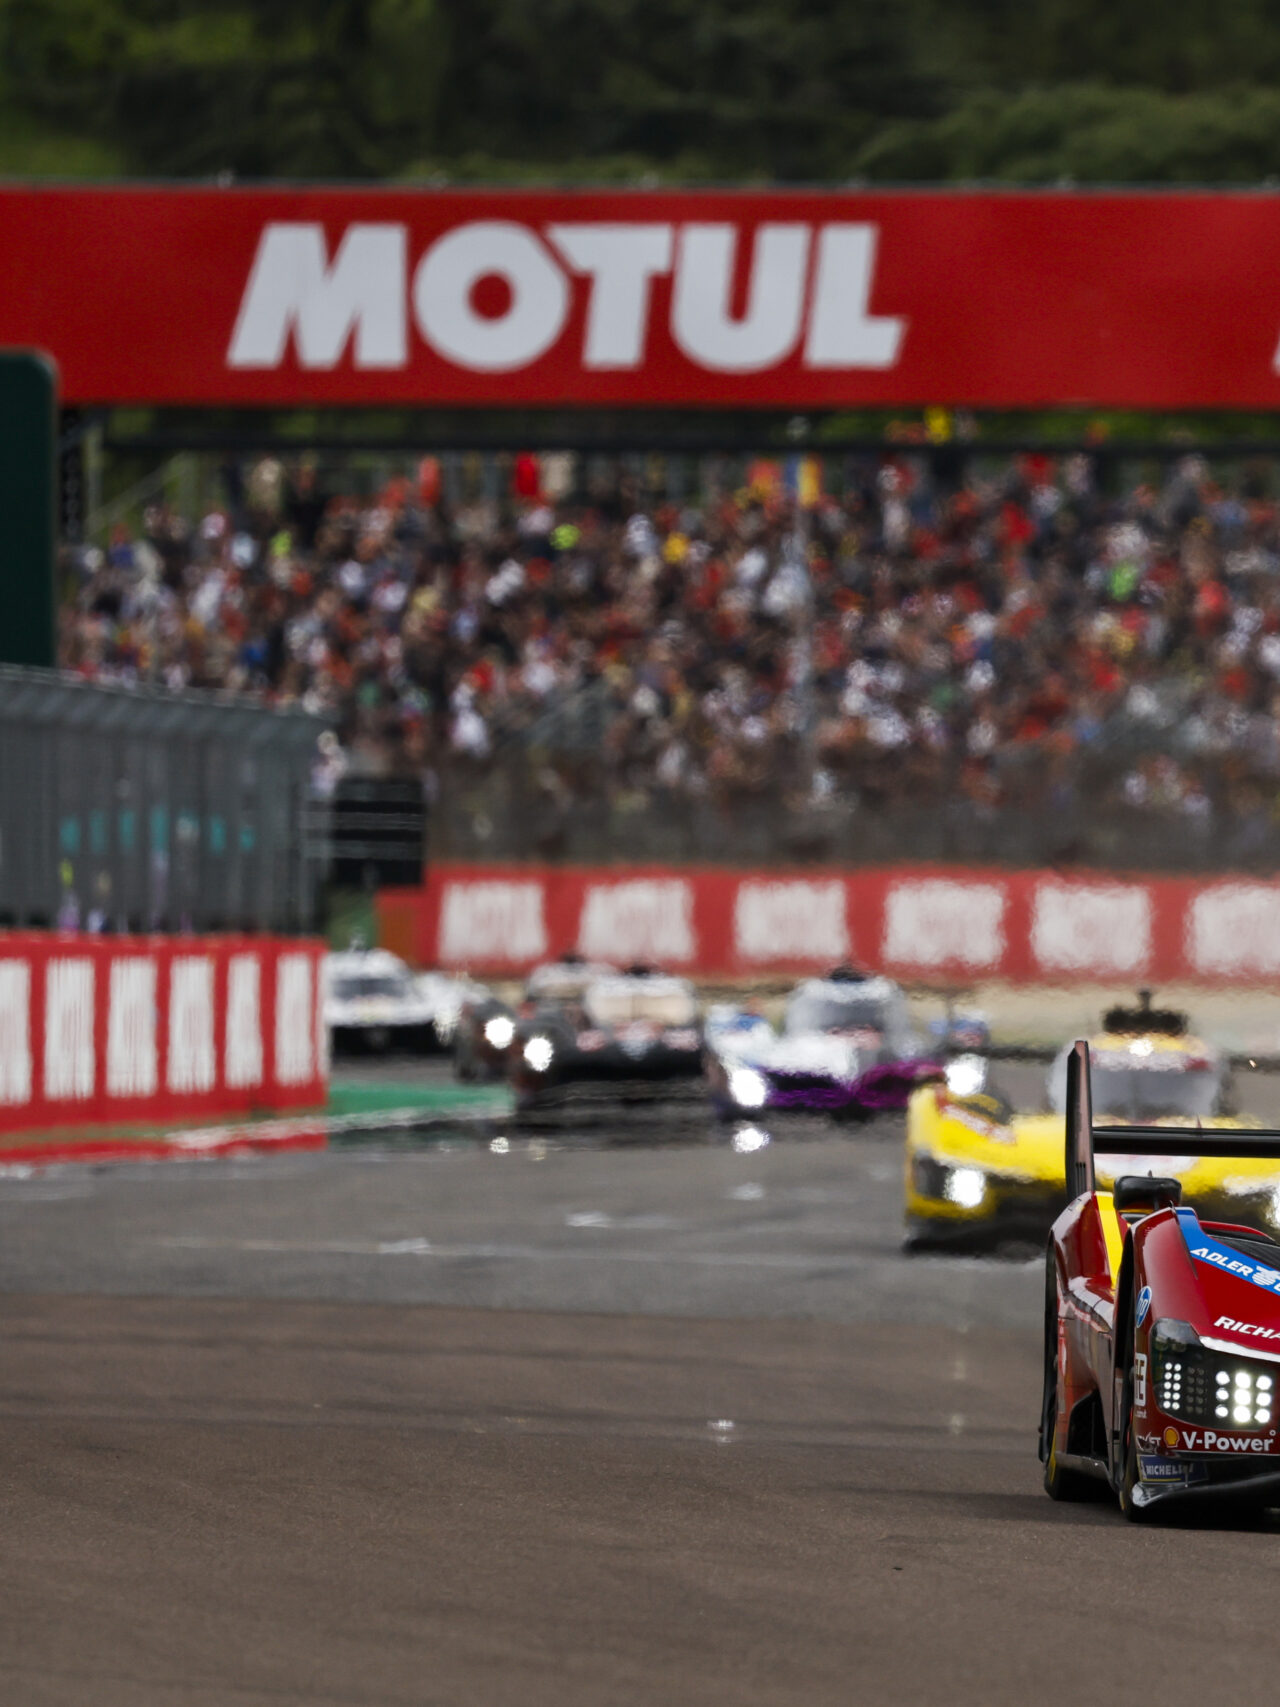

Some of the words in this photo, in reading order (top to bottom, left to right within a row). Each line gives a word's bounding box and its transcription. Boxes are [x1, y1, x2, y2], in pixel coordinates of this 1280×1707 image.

[227, 219, 906, 374] MOTUL
[1191, 1248, 1251, 1277] ADLER
[1182, 1430, 1274, 1451] V-Power
